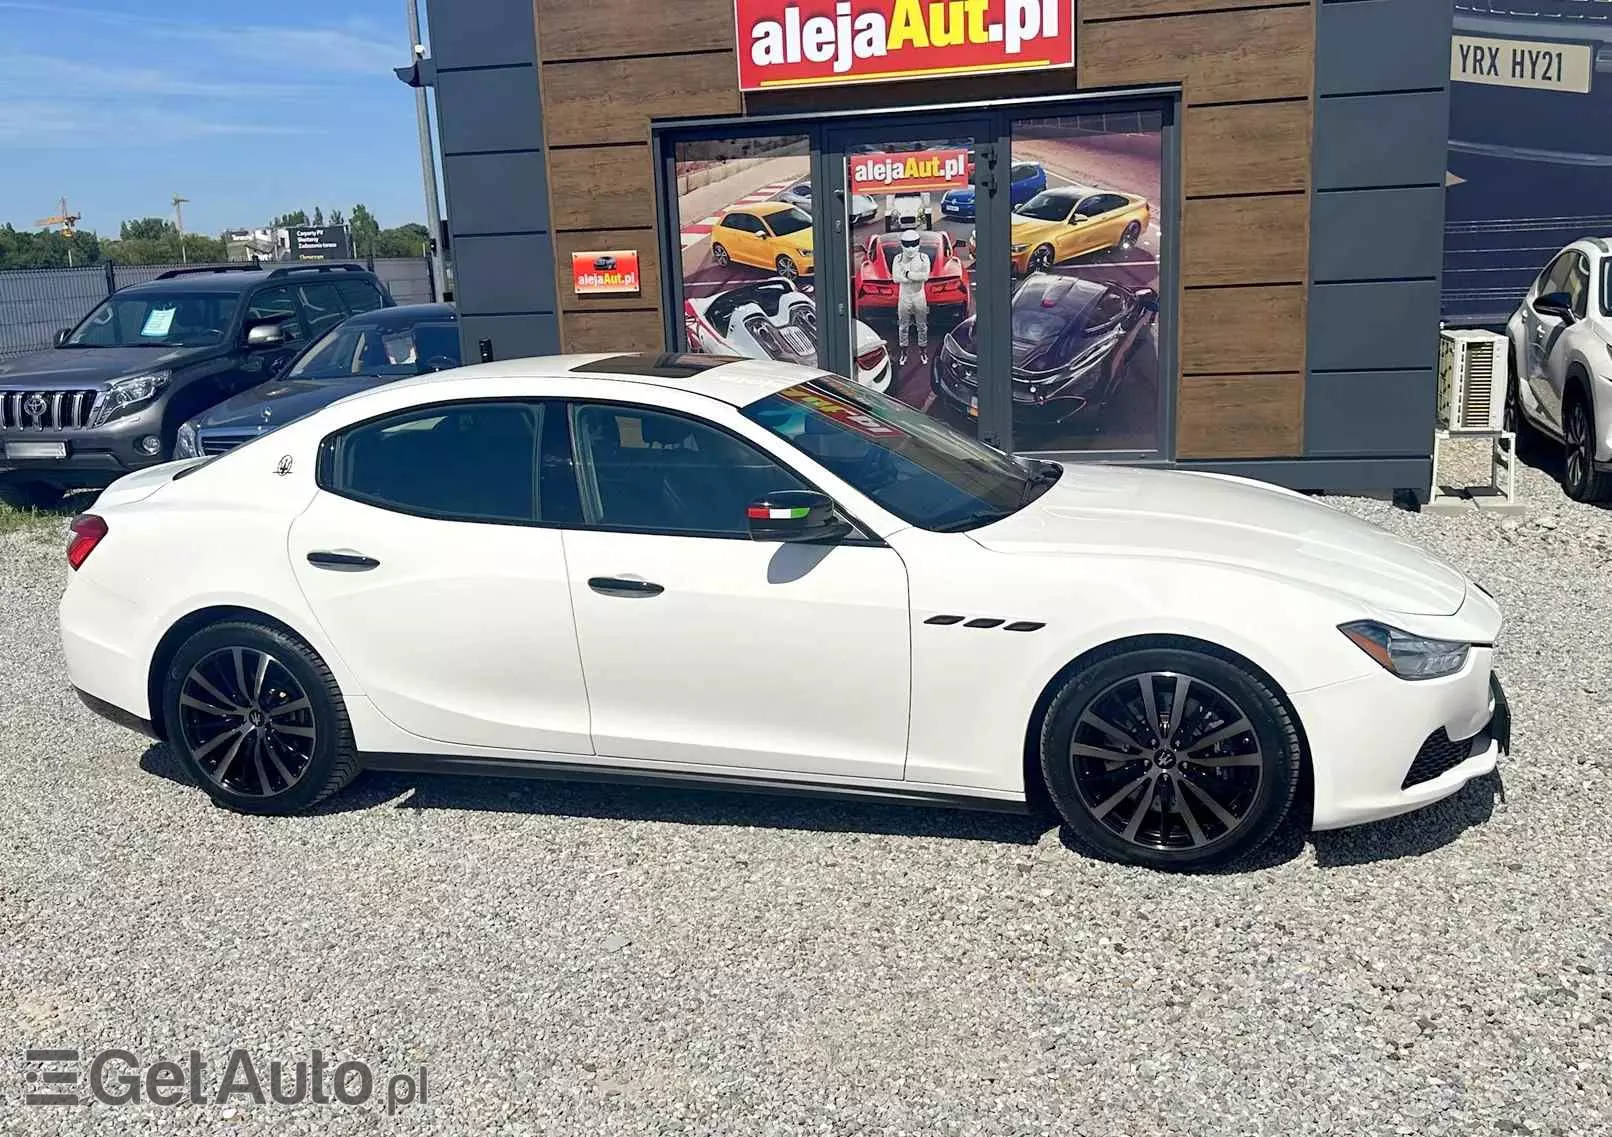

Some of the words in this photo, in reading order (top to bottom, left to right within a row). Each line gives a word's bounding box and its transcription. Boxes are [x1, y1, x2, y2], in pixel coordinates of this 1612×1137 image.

[751, 0, 1058, 73] alejaAut.pl
[1459, 44, 1500, 77] YRX
[1511, 48, 1563, 82] HY21
[855, 154, 965, 185] alejaAut.pl
[578, 271, 635, 287] alejaAut.pl
